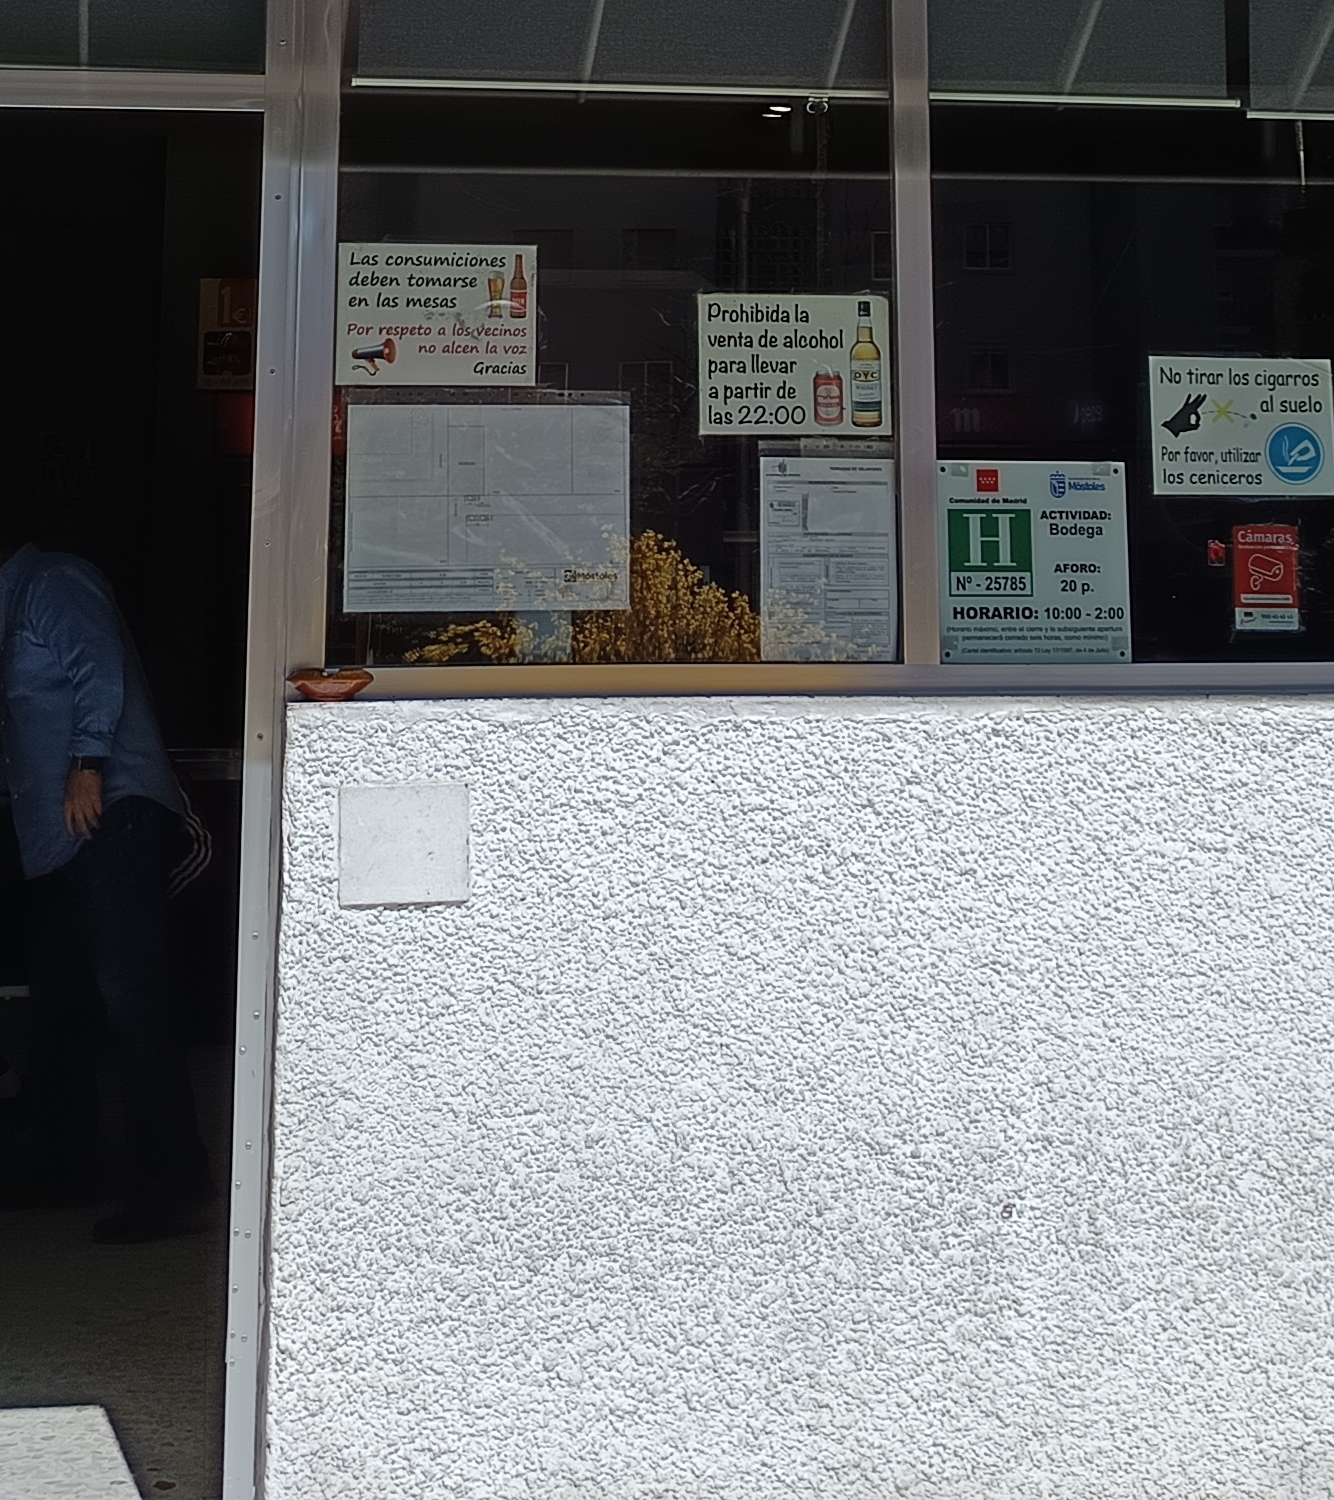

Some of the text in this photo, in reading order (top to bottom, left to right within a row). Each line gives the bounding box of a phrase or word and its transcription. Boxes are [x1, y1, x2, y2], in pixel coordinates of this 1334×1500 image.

[349, 252, 507, 268] Las consumiciones
[348, 271, 478, 288] deben tomarse
[348, 292, 457, 309] en las mesas
[707, 302, 809, 323] Prohibida la
[347, 323, 528, 340] Por respeto a los vecinos
[707, 328, 844, 349] venta de alcohol
[418, 341, 528, 355] no alcen la voz
[473, 361, 527, 375] Gracias
[708, 353, 797, 380] para llevar
[854, 371, 878, 380] DYC
[1159, 366, 1320, 392] No tirar los cigarros
[708, 380, 797, 405] a partir de
[1260, 394, 1323, 414] al suelo
[708, 404, 807, 425] las 22:00
[1161, 445, 1262, 465] Por favor, utilizar
[1163, 468, 1263, 486] los ceniceros
[949, 497, 1028, 505] Comunidad de Madrid
[1040, 510, 1112, 521] ACTIVIDAD:
[1049, 523, 1104, 539] Bodega
[1237, 529, 1293, 543] Cámaras
[963, 513, 1017, 567] H
[1053, 563, 1101, 574] AFORO:
[985, 576, 1027, 592] 25785
[1060, 579, 1095, 595] 20 p.
[952, 606, 1039, 620] HORARIO:
[1043, 607, 1082, 620] 10:00
[1094, 607, 1125, 620] 2:00
